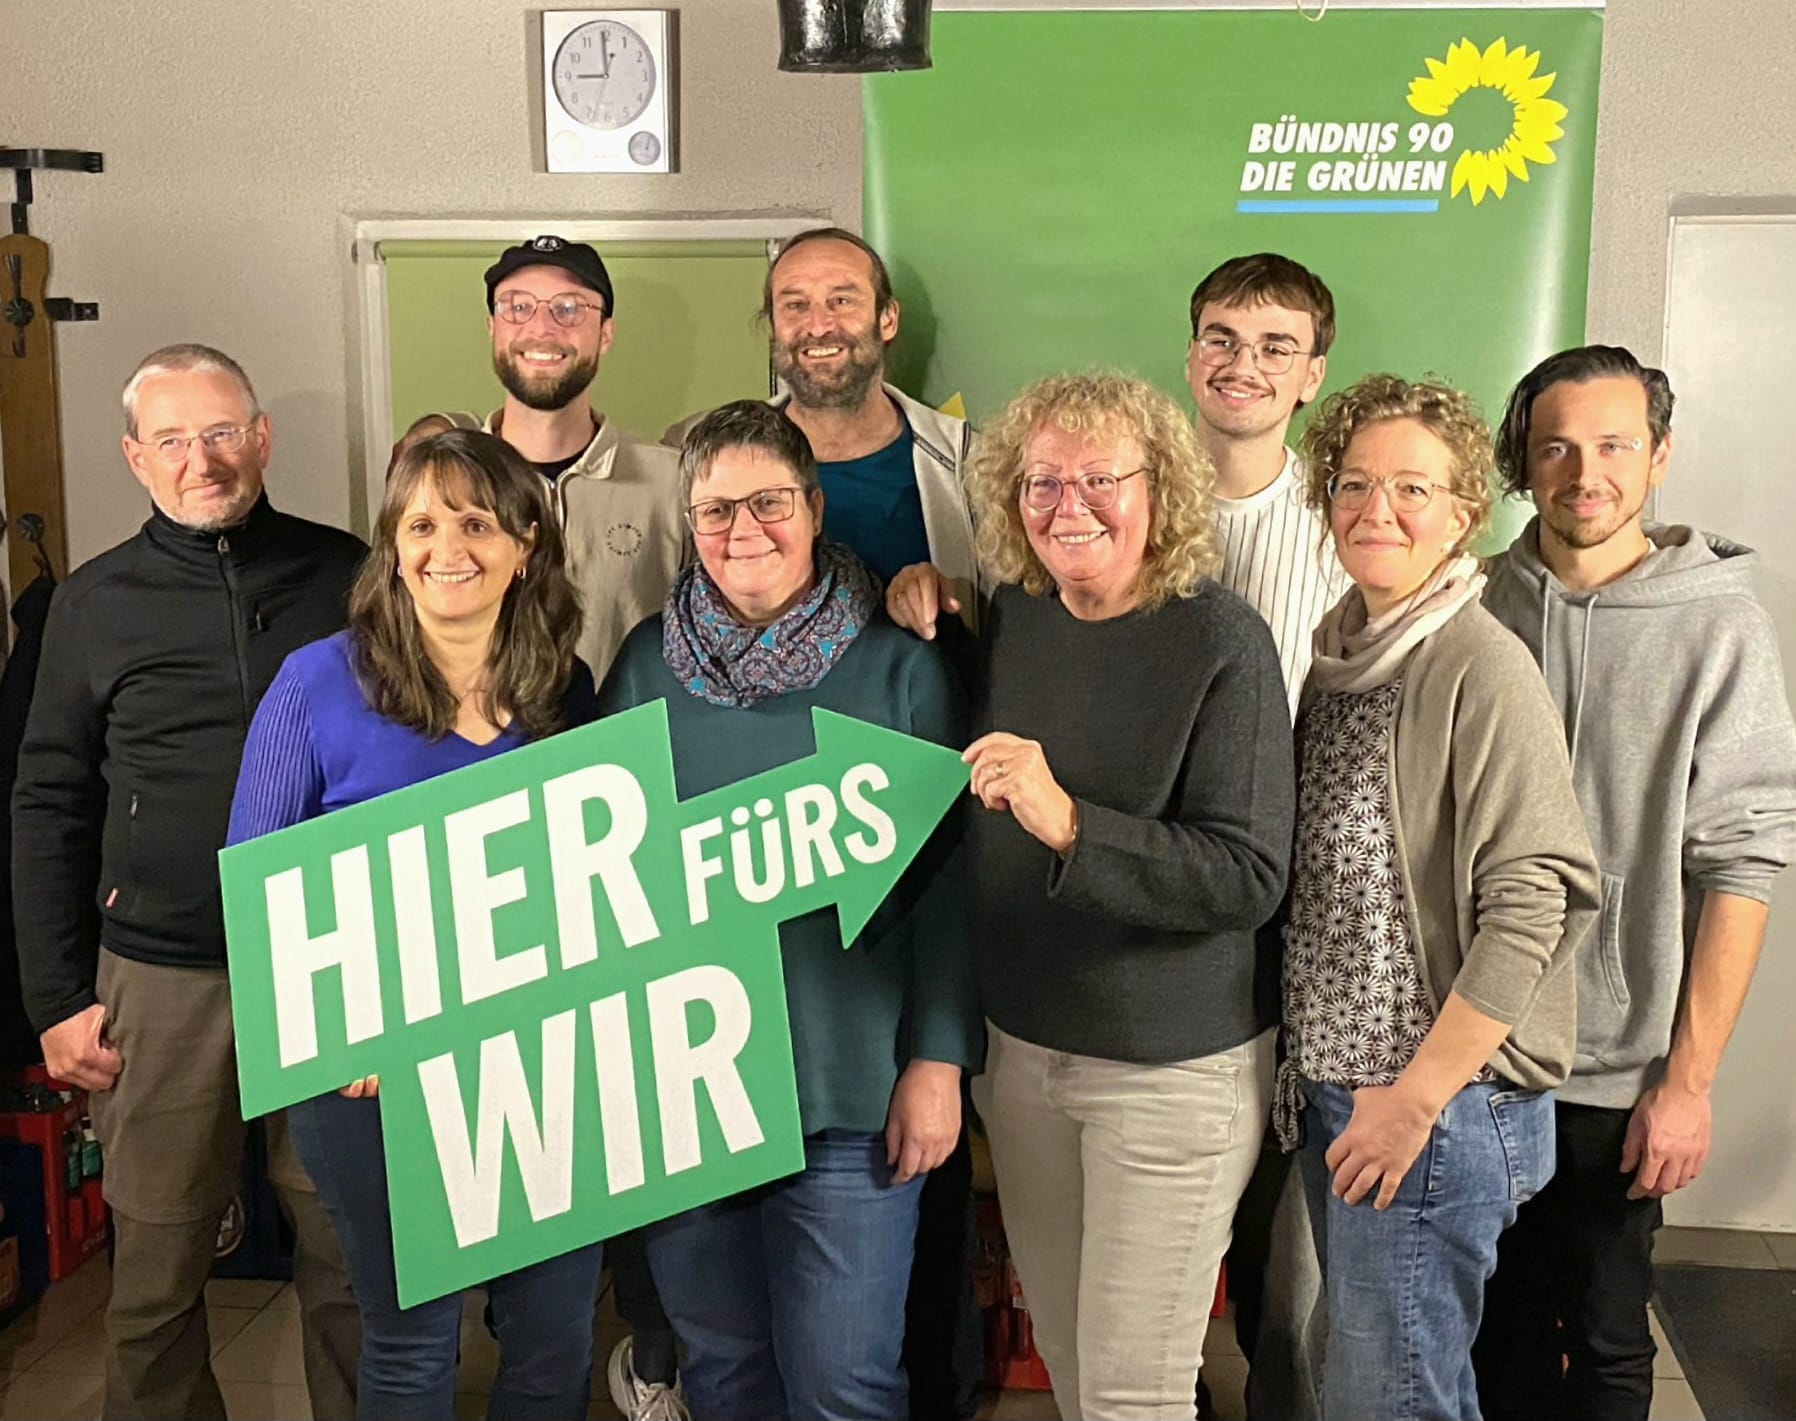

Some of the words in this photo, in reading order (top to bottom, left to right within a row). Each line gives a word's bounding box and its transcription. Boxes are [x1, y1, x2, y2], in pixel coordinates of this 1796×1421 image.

[583, 37, 591, 48] 11
[622, 37, 627, 48] 1
[570, 53, 581, 64] 10
[636, 52, 643, 63] 2
[564, 71, 571, 82] 9
[1248, 114, 1399, 153] BÜNDNIS
[1408, 122, 1454, 153] 90
[1240, 161, 1296, 192] DIE
[1307, 153, 1448, 192] GRÜNEN
[264, 764, 661, 1069] HIER
[680, 763, 897, 925] FÜRS
[417, 965, 765, 1249] WIR
